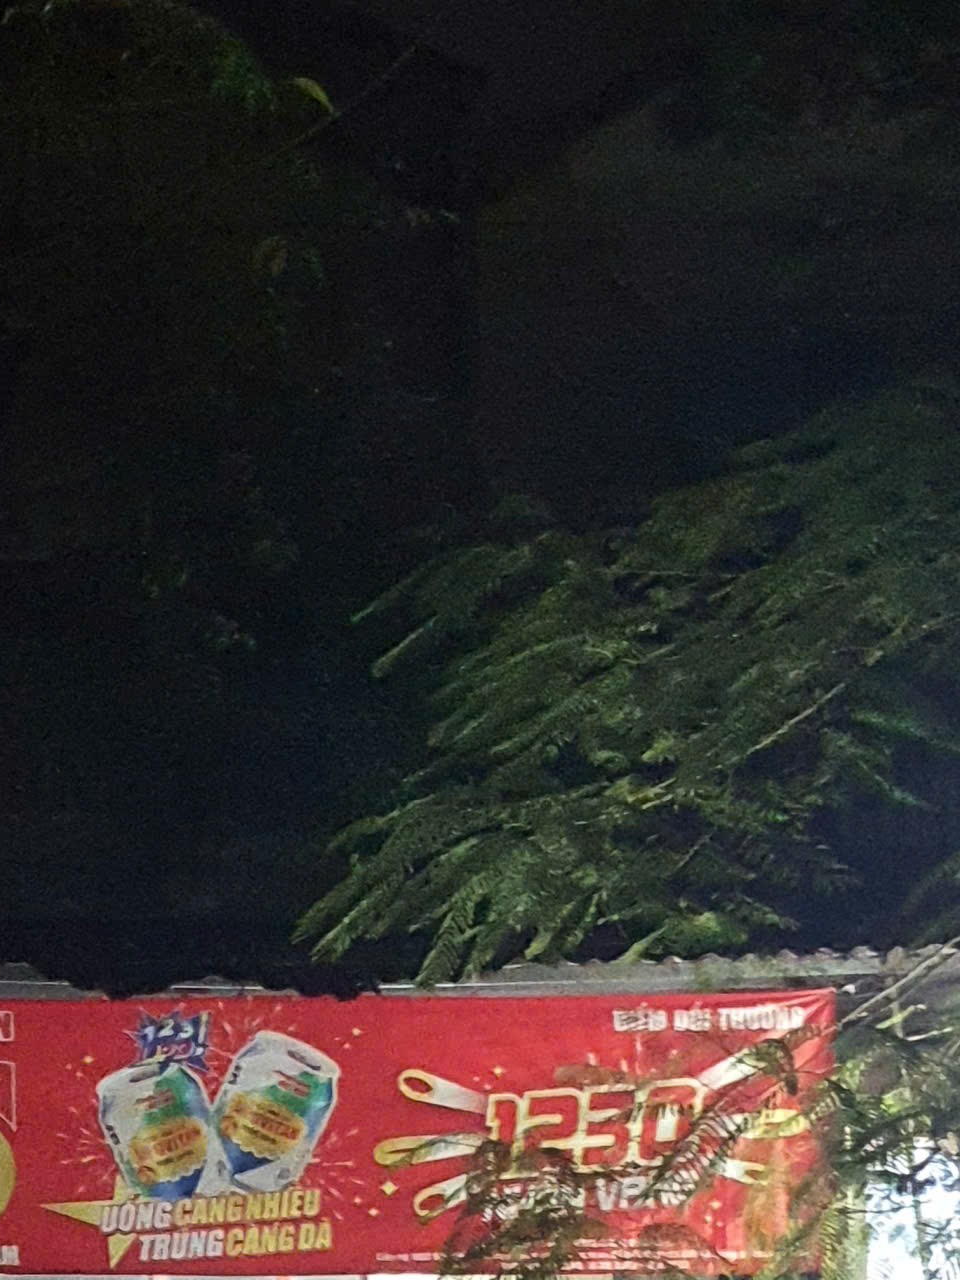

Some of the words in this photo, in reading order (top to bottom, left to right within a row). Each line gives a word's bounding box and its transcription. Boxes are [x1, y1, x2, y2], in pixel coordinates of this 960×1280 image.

[101, 1194, 174, 1233] UỐNG
[139, 1226, 225, 1262] TRÚNG
[226, 1219, 296, 1257] CÀNG
